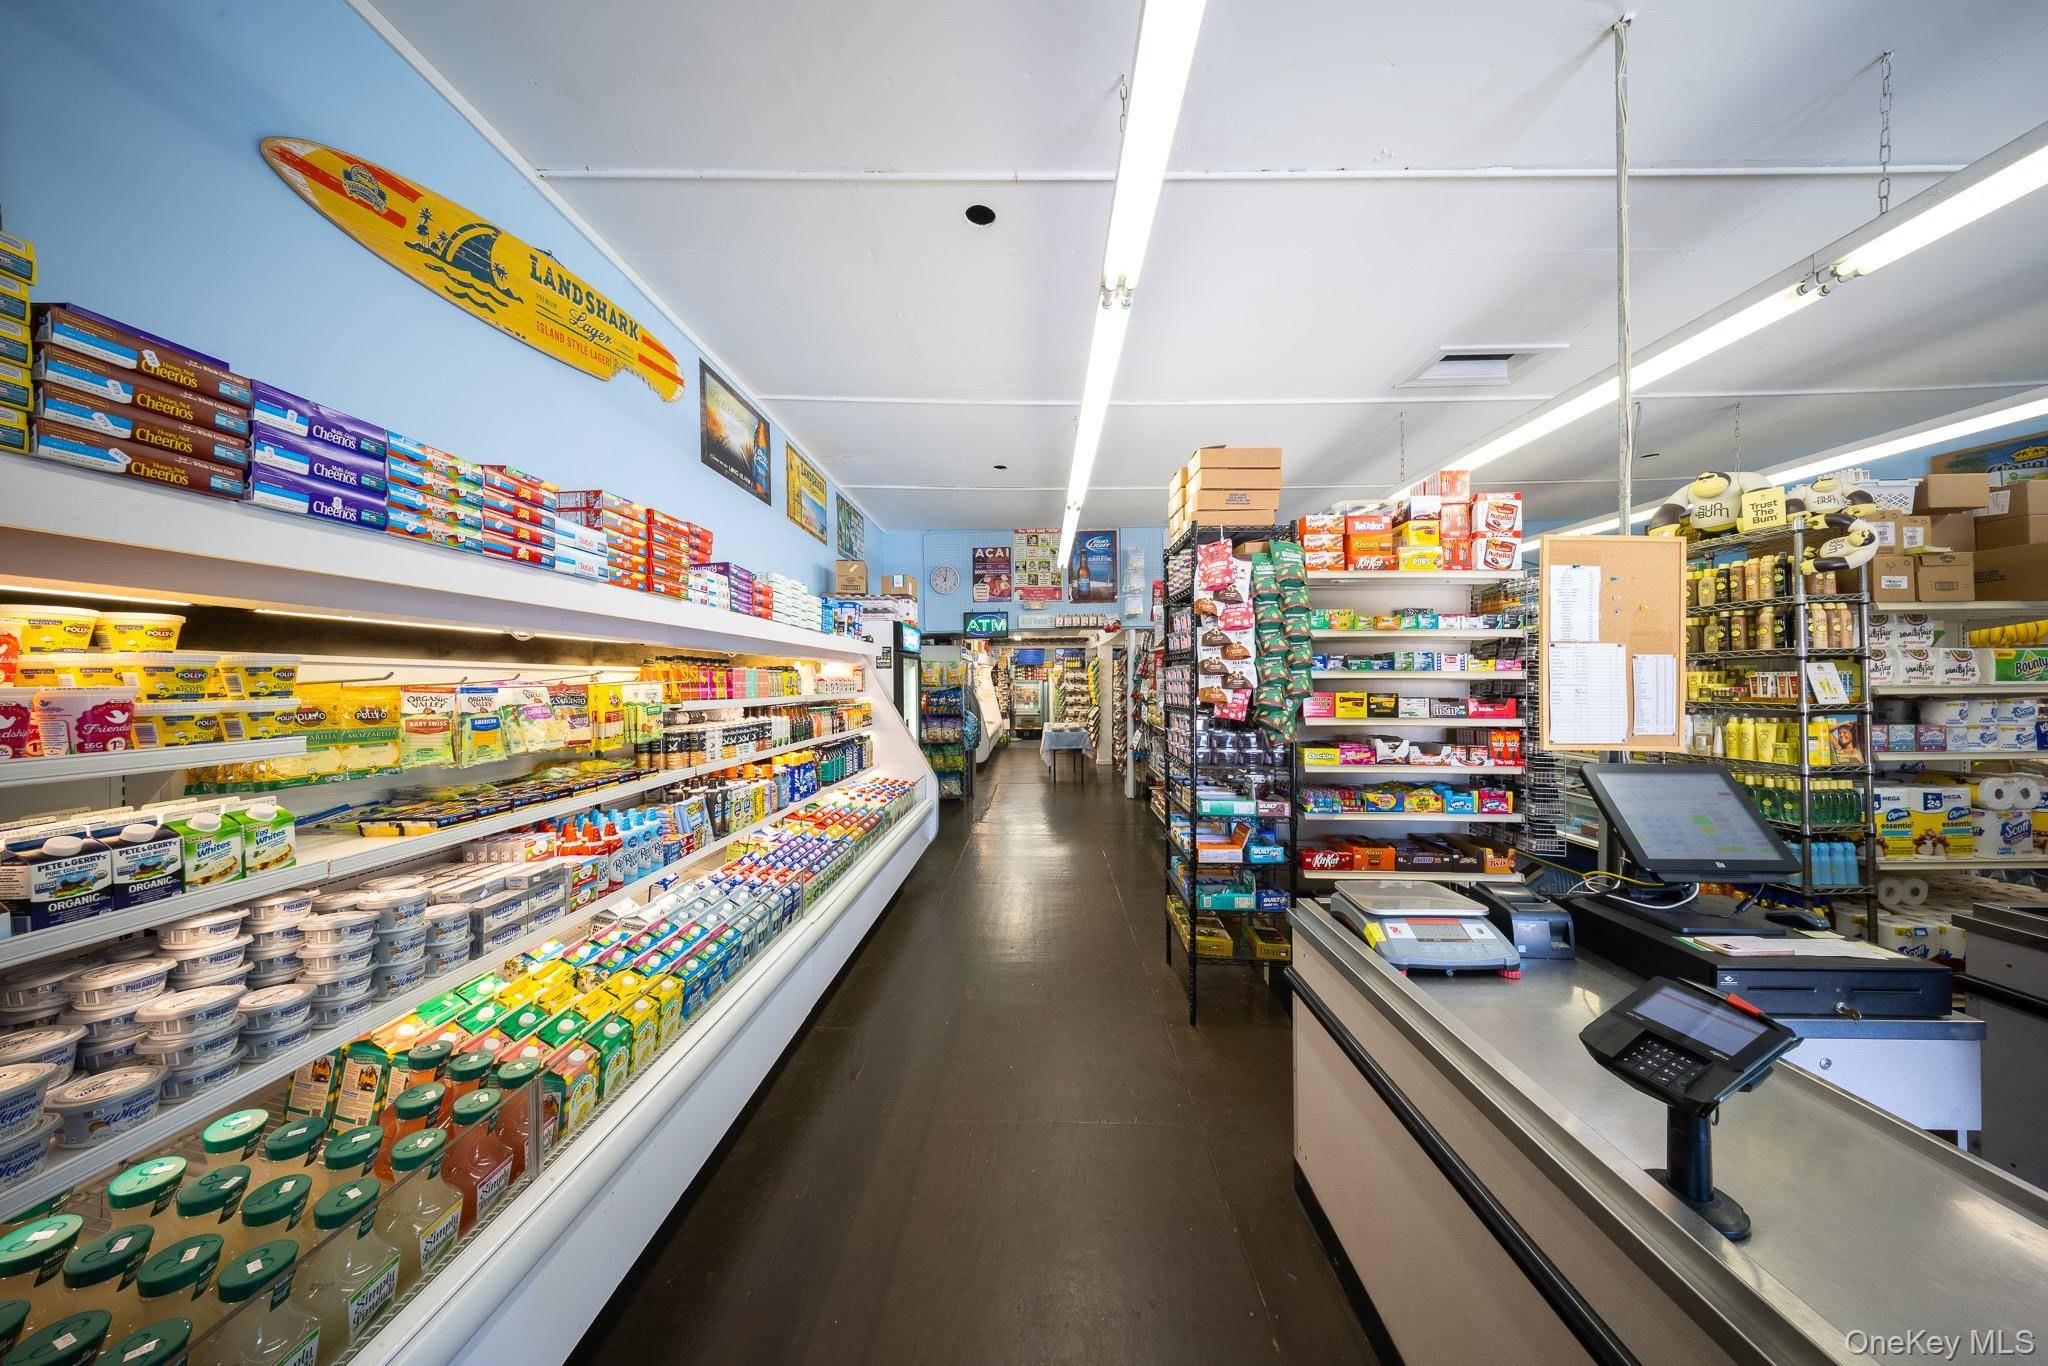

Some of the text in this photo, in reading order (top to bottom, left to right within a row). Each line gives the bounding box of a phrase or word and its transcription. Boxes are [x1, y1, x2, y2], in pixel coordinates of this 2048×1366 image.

[529, 253, 640, 342] LANDSHARK
[568, 308, 614, 343] Lager
[536, 320, 566, 344] ISLAND
[567, 336, 590, 356] STYLE
[589, 347, 611, 367] LAGER
[136, 393, 194, 421] Cheerios
[135, 427, 193, 454] Cheerios
[312, 425, 357, 450] Cheerios
[131, 461, 189, 486] Cheerios
[313, 463, 358, 487] Cheerios
[1749, 500, 1778, 511] Trust
[1754, 508, 1775, 517] The
[1490, 512, 1515, 521] nutella
[1752, 515, 1777, 524] Bum
[975, 548, 1009, 559] AÇAI
[1488, 550, 1513, 559] nutella
[580, 562, 594, 573] Total
[966, 619, 1006, 631] ATM
[2015, 656, 2048, 675] Bounty
[407, 695, 449, 708] ORGANIC
[474, 718, 497, 726] AMERICAN
[348, 729, 396, 739] MOZZARELLA
[1926, 800, 1941, 809] 24
[255, 829, 269, 837] Egg
[256, 829, 286, 845] Whites
[2005, 821, 2030, 839] Scott
[119, 847, 141, 857] PETE
[196, 840, 212, 849] Egg
[198, 841, 231, 858] Whites
[37, 862, 64, 873] PETE
[1312, 852, 1339, 868] KitKat
[45, 862, 99, 877] PURE EGG WHITES
[128, 876, 172, 894] ORGANIC
[48, 893, 100, 912] ORGANIC
[1264, 896, 1280, 904] BUILT
[482, 1170, 509, 1196] Simply
[425, 1212, 459, 1246] Simply
[356, 1271, 396, 1307] Simply
